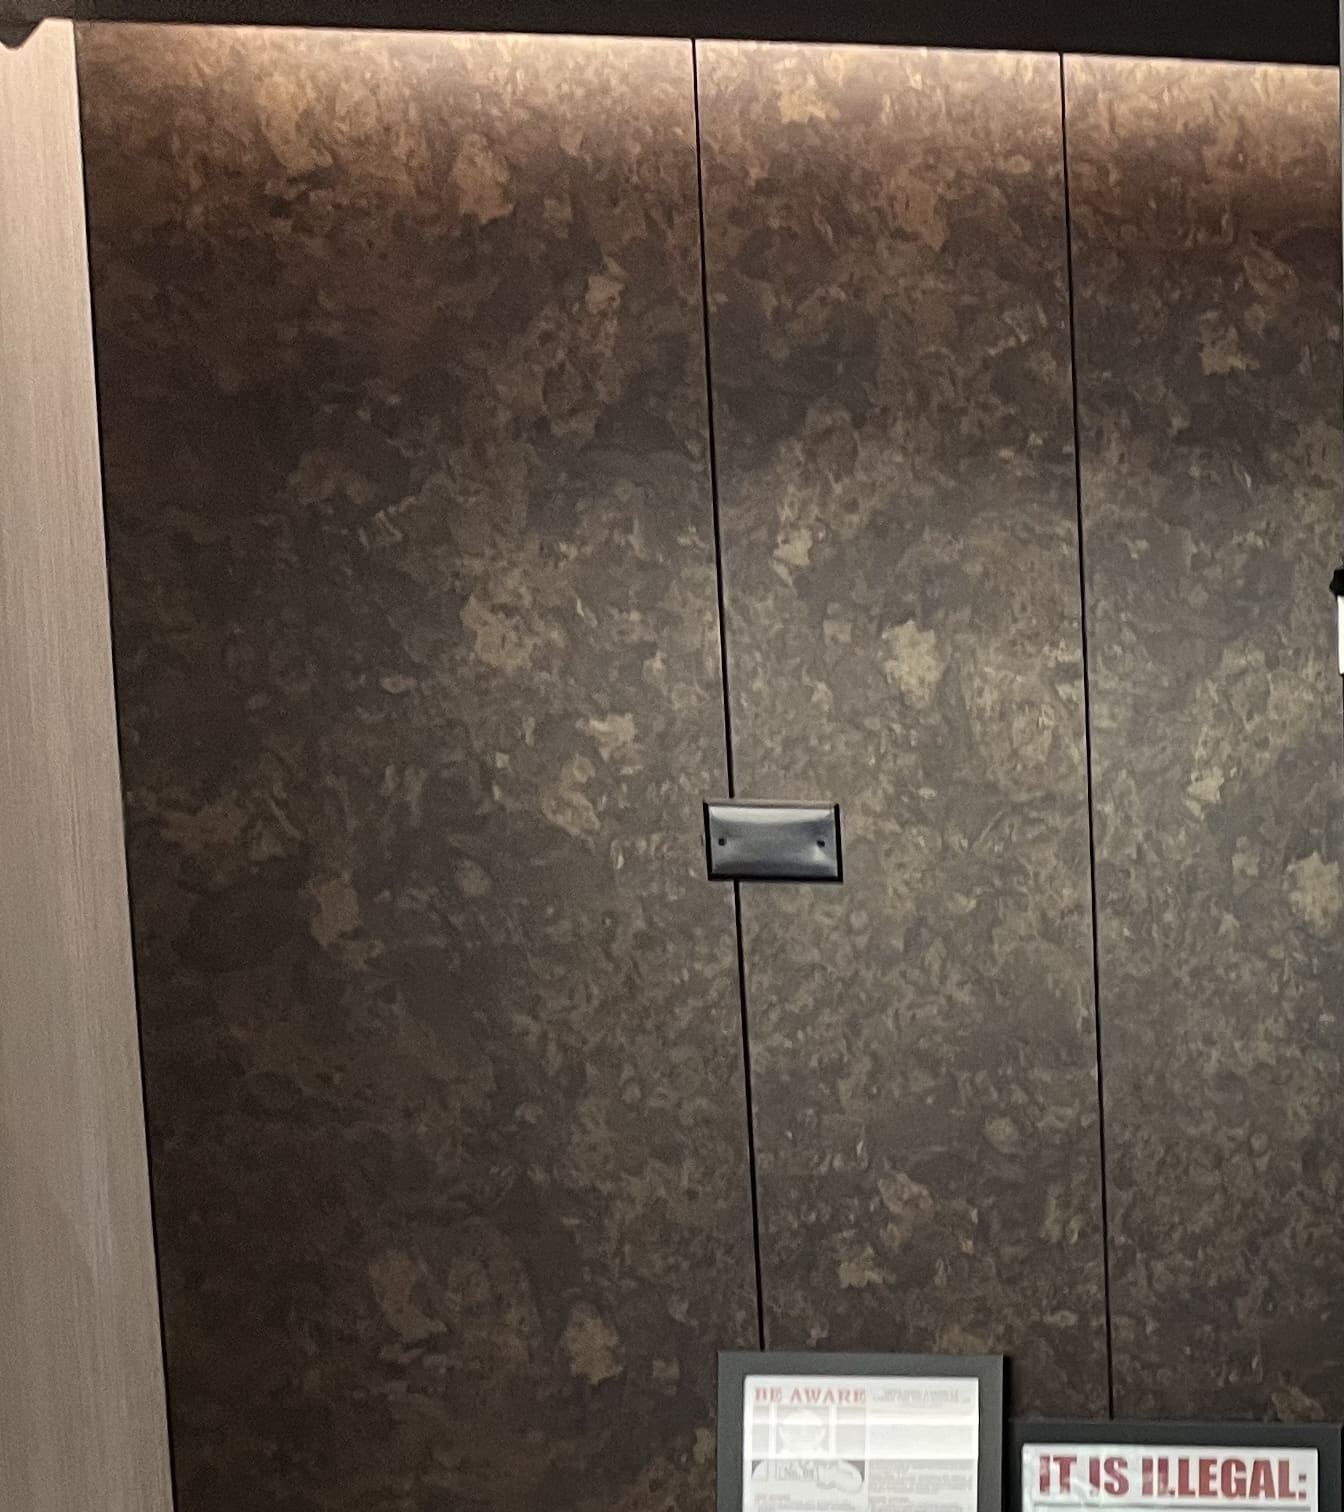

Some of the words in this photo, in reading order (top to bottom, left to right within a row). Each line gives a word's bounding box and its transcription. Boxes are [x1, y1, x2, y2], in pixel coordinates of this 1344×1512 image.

[1039, 1455, 1077, 1496] IT
[1089, 1456, 1129, 1496] IS
[1141, 1457, 1307, 1500] ILLEGAL:
